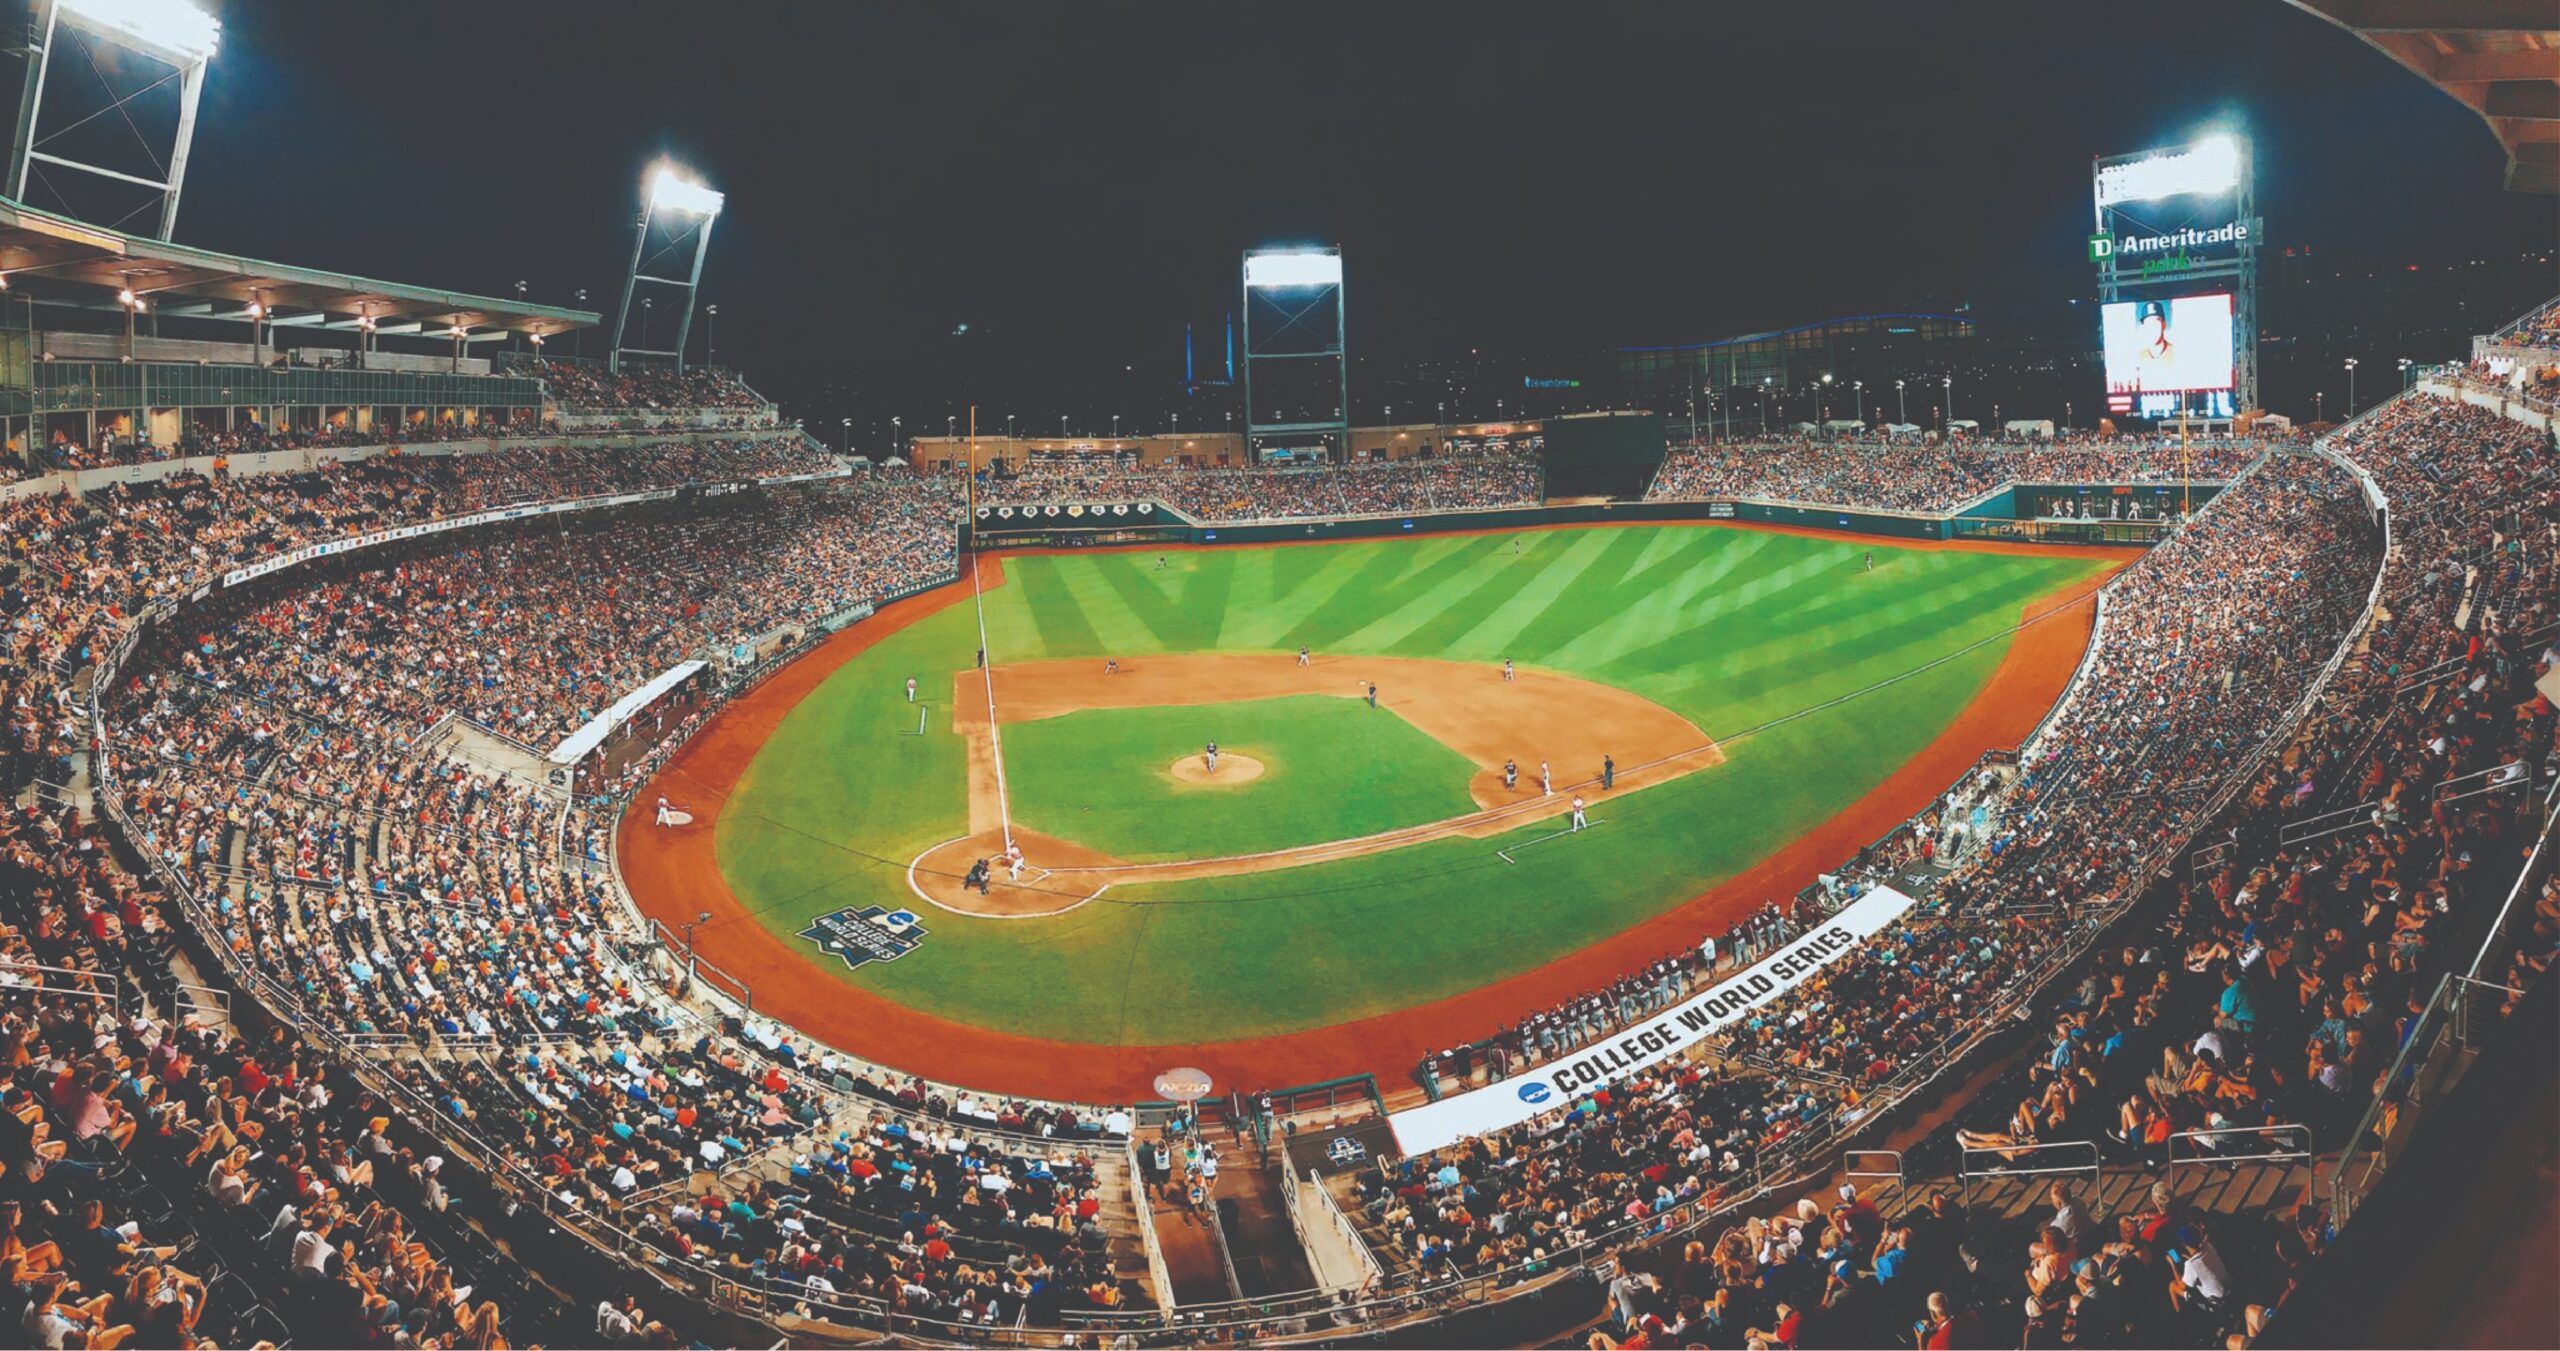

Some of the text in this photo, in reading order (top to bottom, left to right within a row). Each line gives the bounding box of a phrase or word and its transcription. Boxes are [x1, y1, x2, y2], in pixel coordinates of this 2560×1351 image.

[2090, 222, 2248, 257] TD Ameritrade
[843, 919, 892, 945] COLLEGE
[850, 935, 897, 960] SERIES
[1551, 1022, 1682, 1094] COLLEGE
[1676, 972, 1775, 1033] WORLD
[1769, 926, 1853, 981] SERIES
